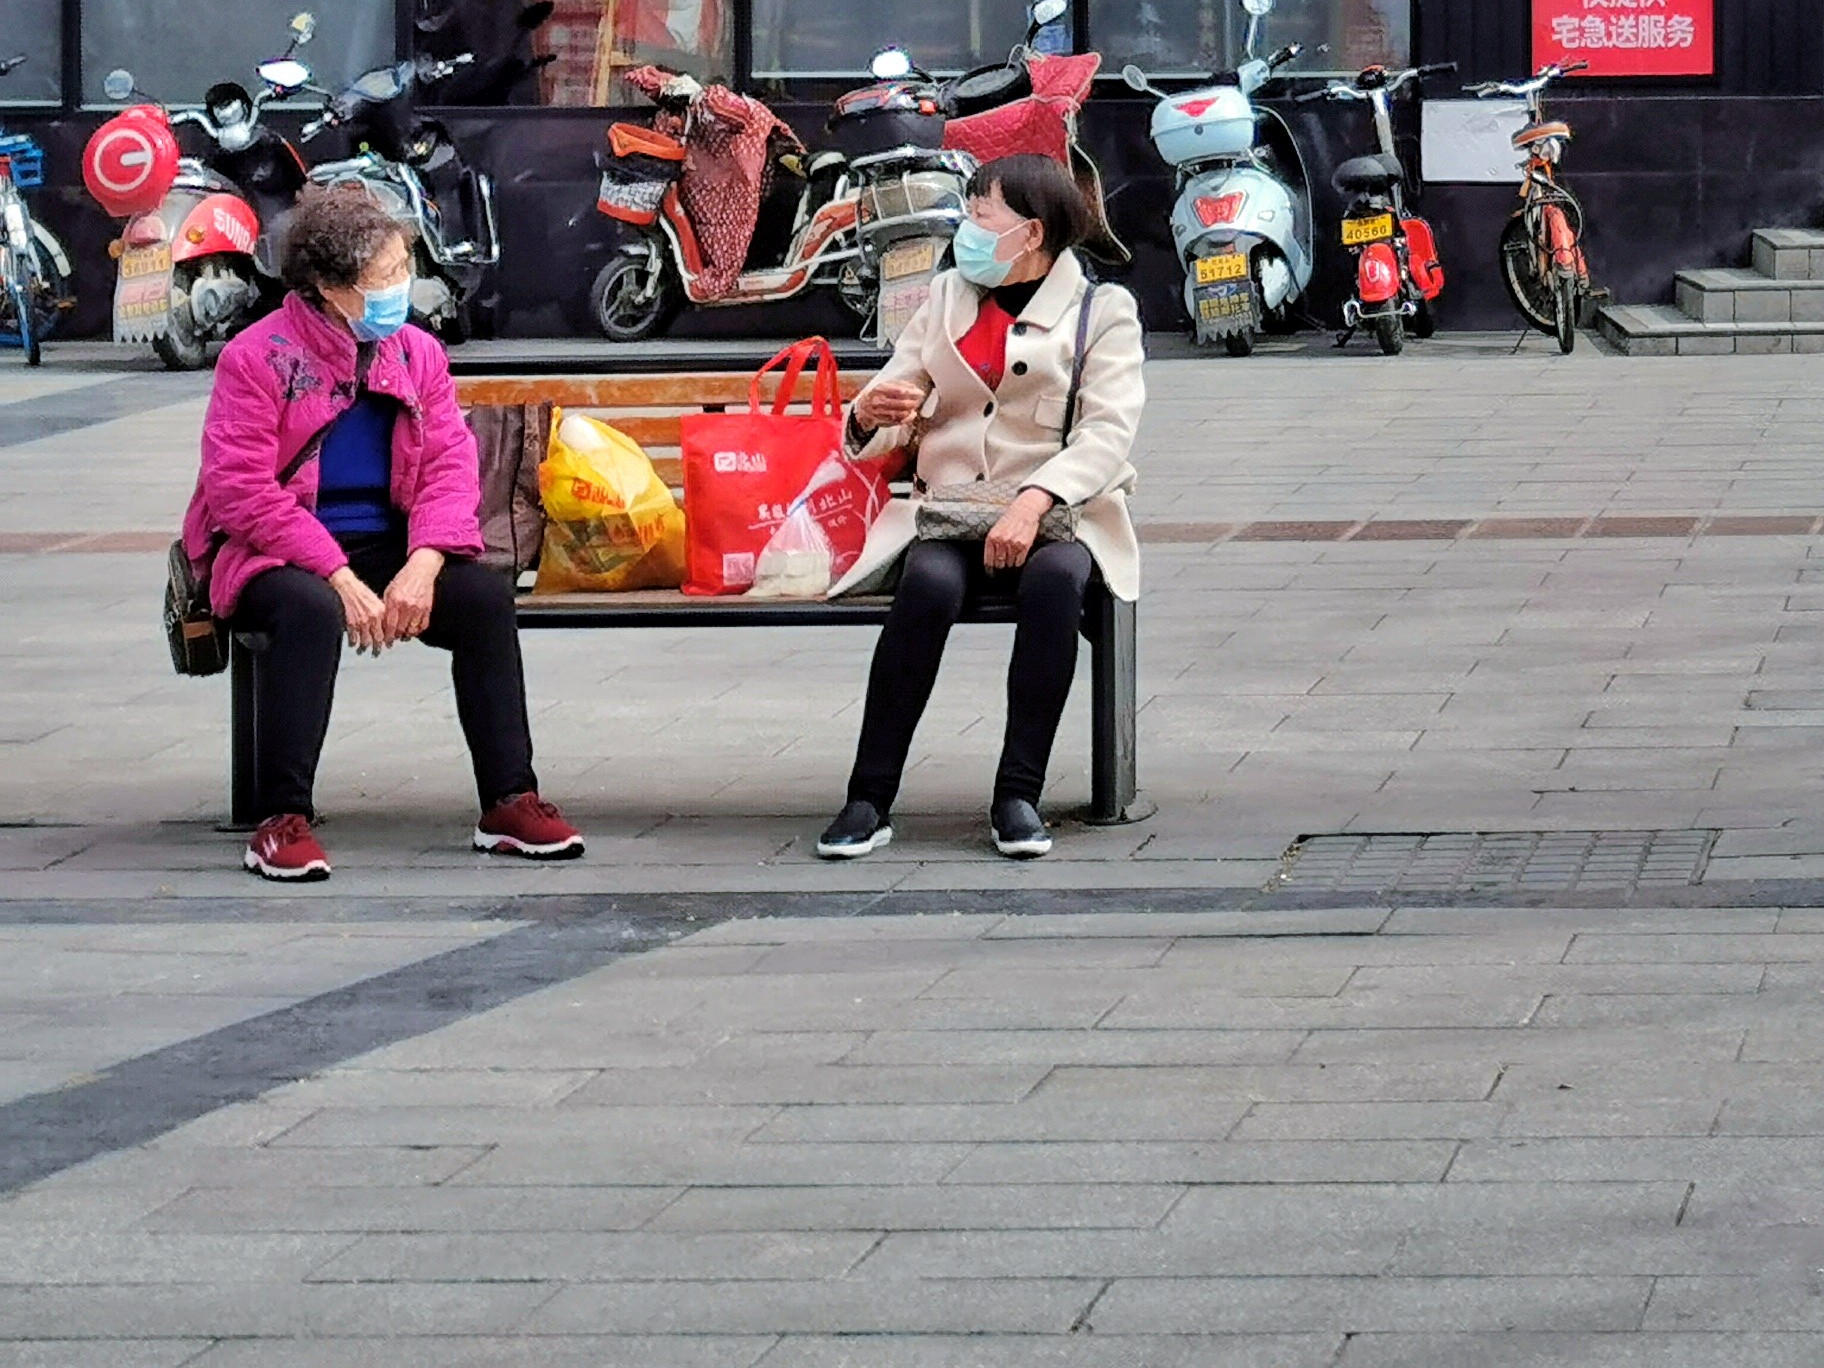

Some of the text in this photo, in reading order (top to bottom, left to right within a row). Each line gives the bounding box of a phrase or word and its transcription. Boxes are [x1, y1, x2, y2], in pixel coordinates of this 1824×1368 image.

[1551, 14, 1695, 49] 宅急送服务
[1200, 264, 1242, 280] 51712
